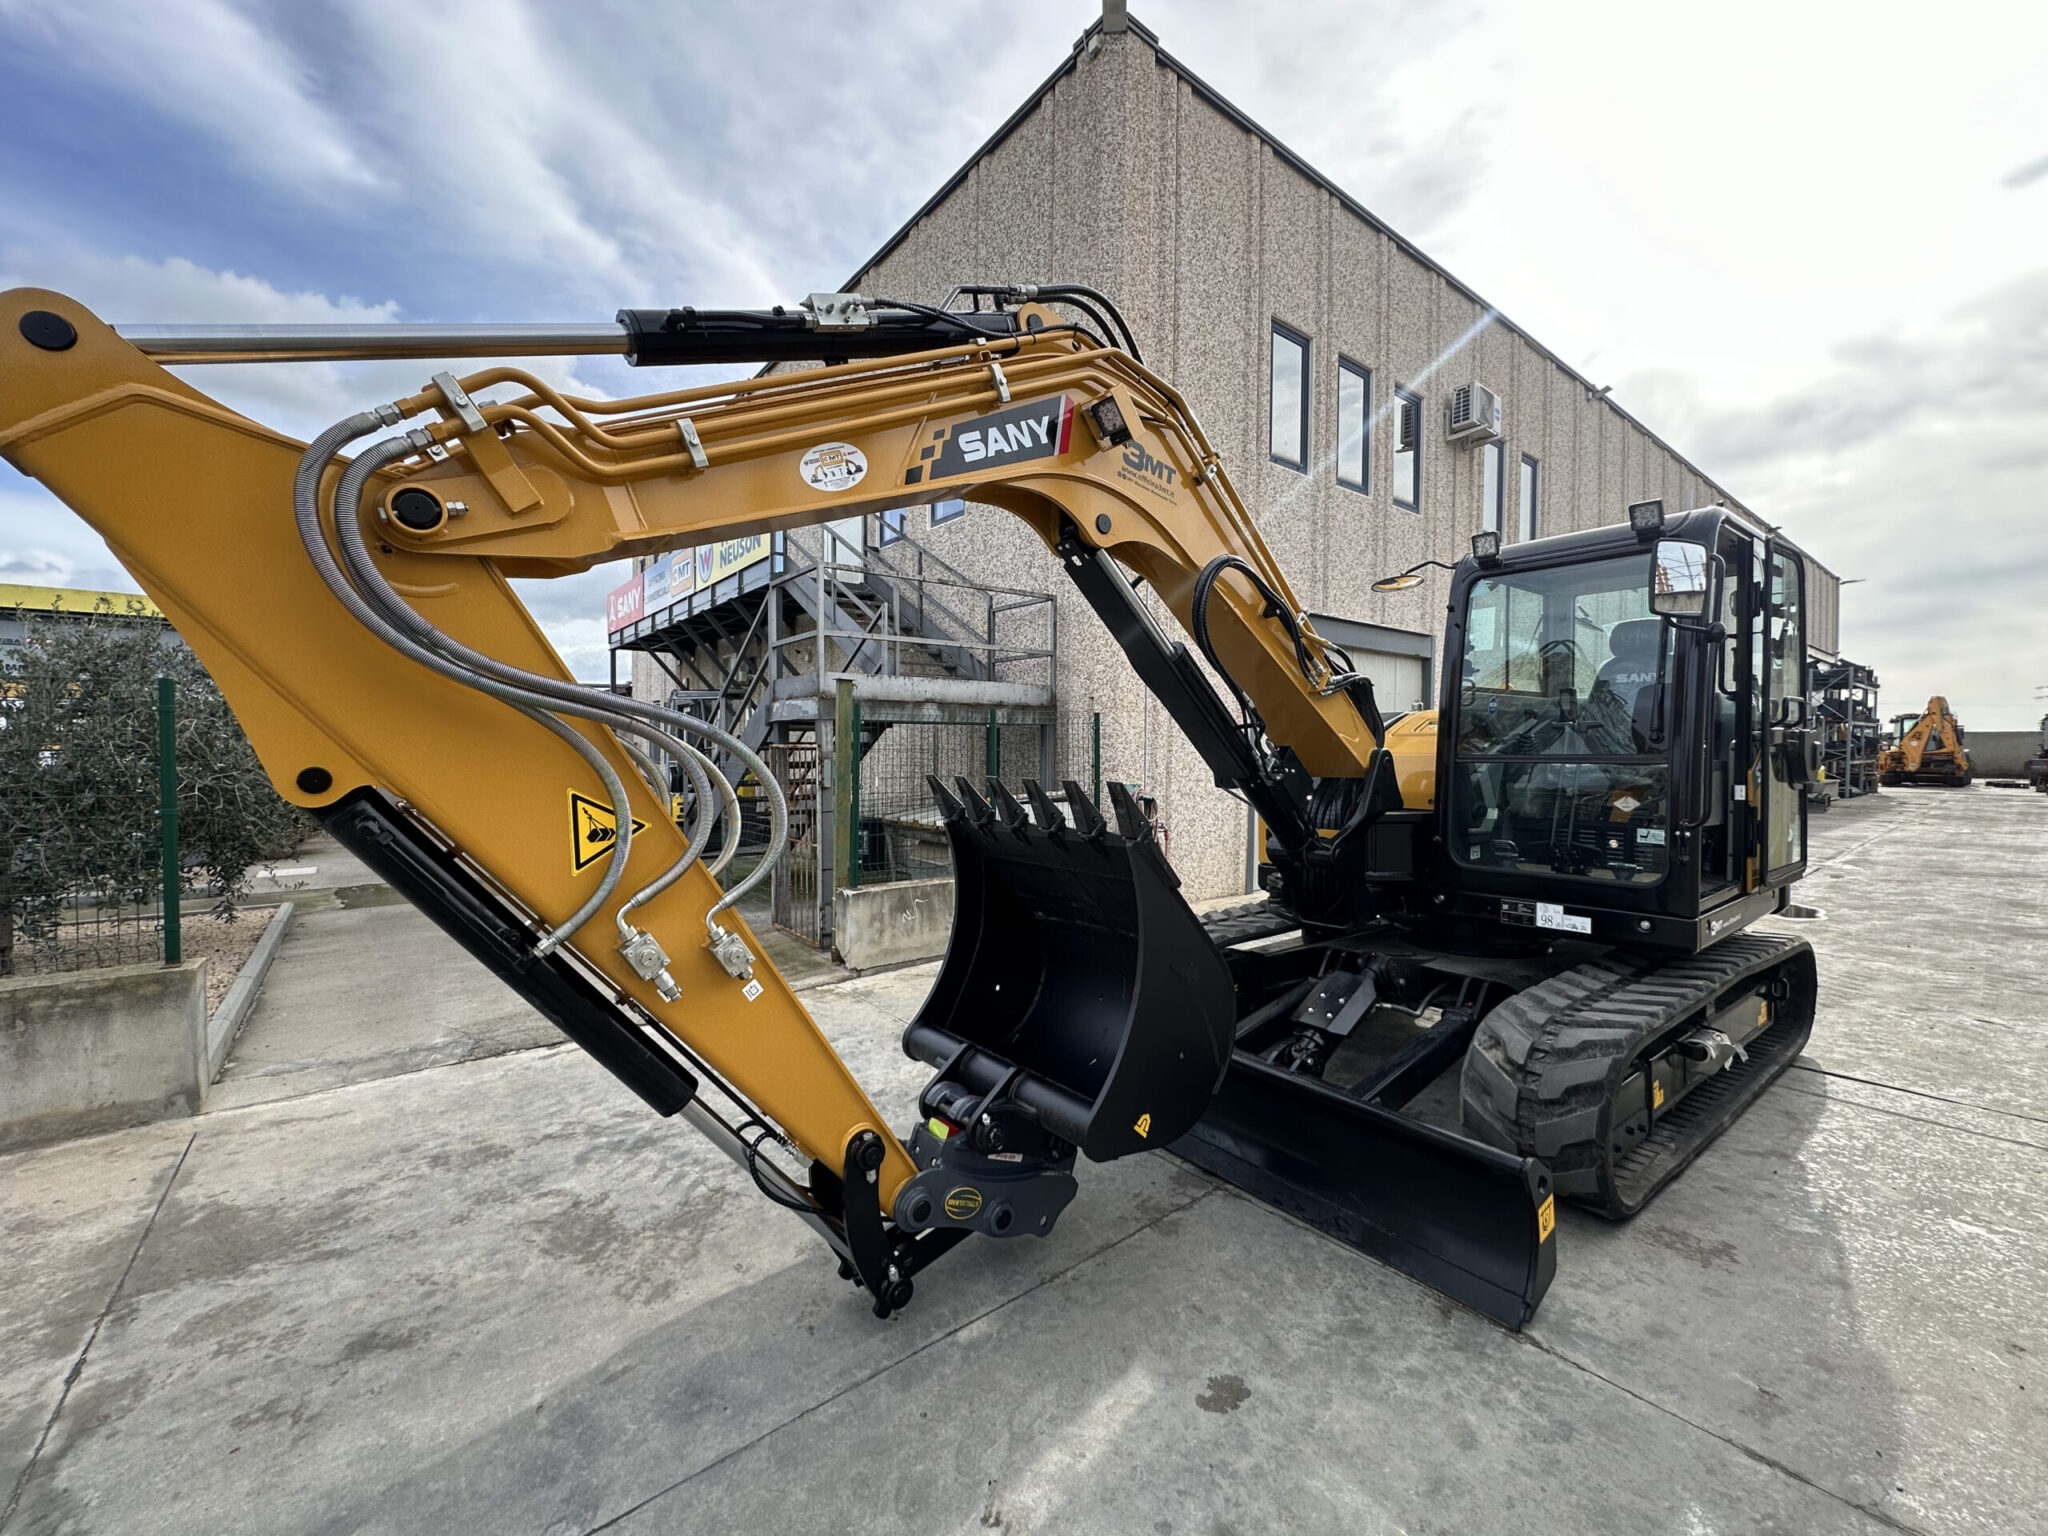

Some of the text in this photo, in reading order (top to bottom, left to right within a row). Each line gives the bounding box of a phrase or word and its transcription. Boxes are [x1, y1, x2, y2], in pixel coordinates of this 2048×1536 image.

[958, 415, 1050, 463] SANY
[1122, 440, 1177, 485] 3MT
[720, 535, 761, 569] NEUSON
[617, 586, 641, 619] SANY
[1540, 913, 1554, 927] 98
